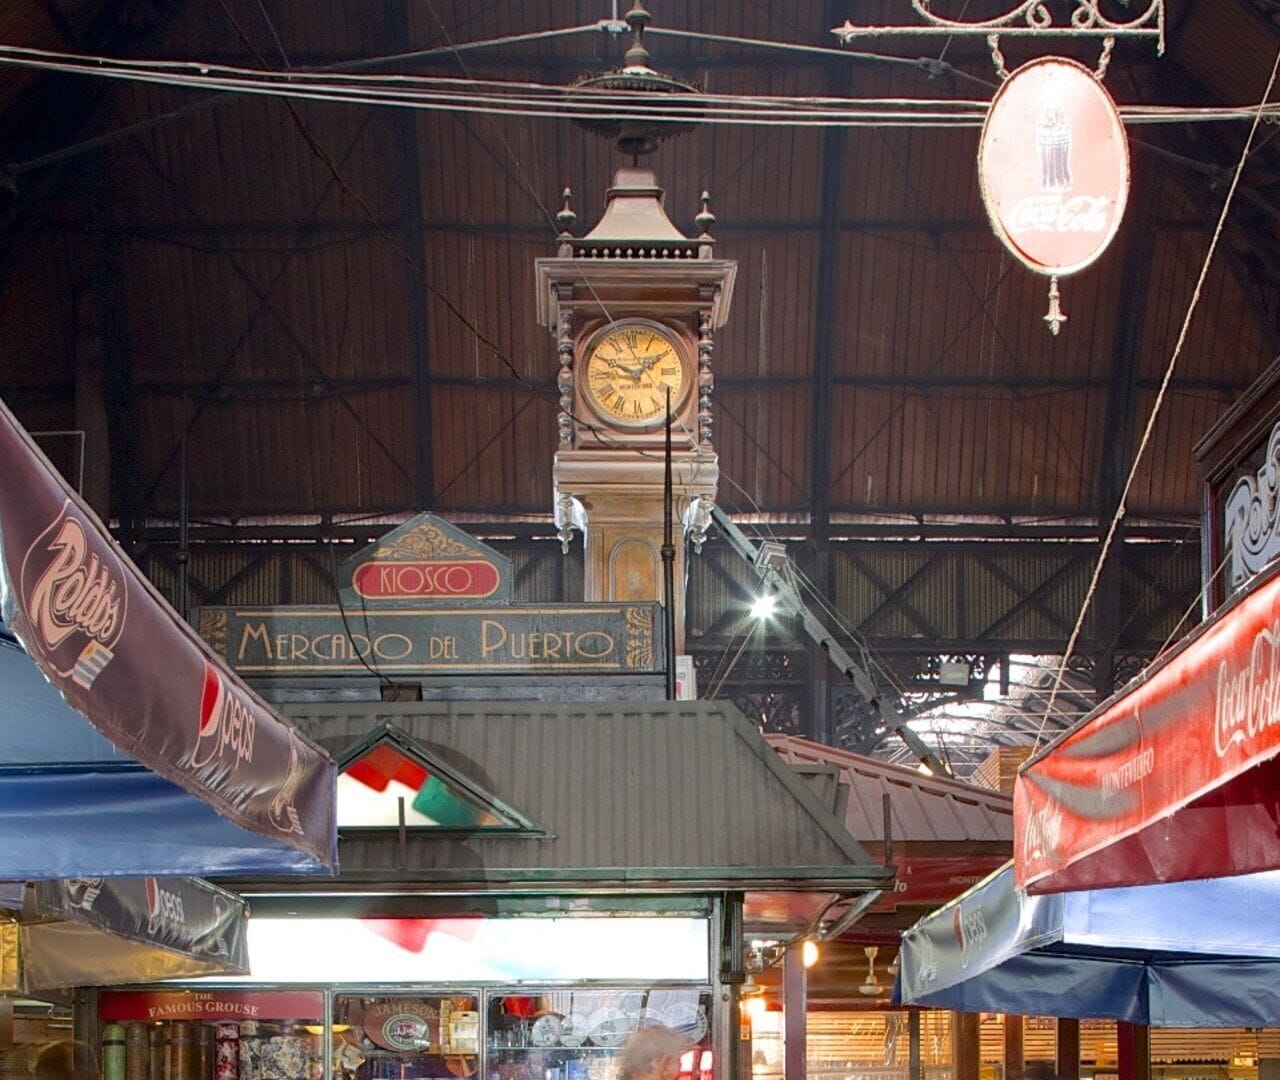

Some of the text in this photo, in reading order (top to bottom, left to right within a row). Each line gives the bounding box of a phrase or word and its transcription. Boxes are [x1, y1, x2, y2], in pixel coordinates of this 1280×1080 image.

[380, 564, 472, 594] KIOSCO
[238, 618, 615, 661] MERCADO DEL PUERTO
[194, 992, 214, 1001] THE
[148, 1000, 260, 1018] FAMOUS GROUSE
[374, 1001, 438, 1018] JAMESON
